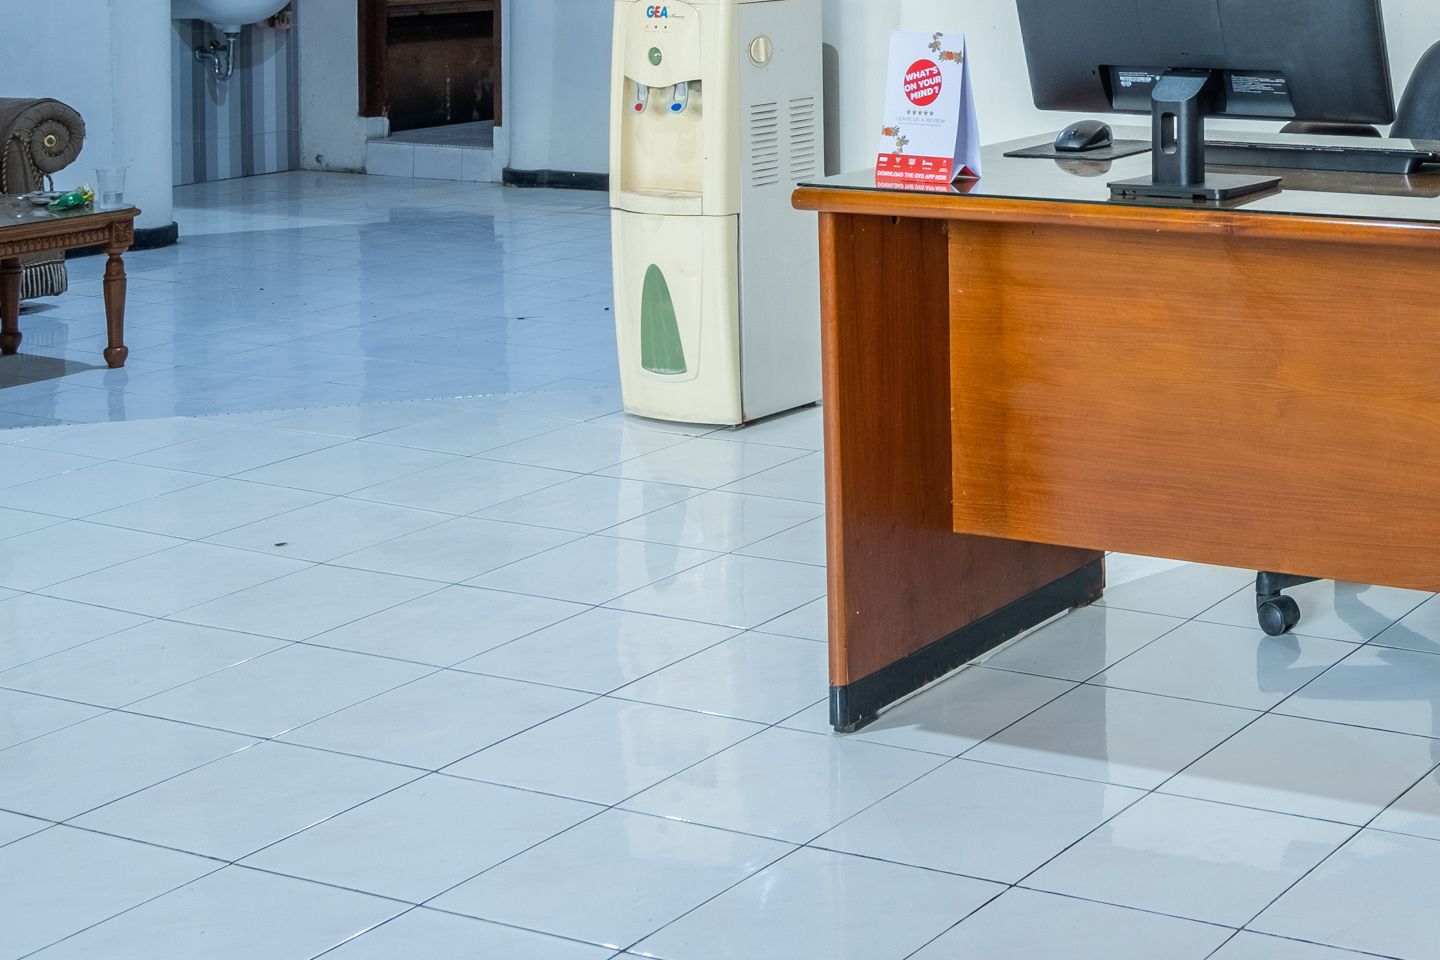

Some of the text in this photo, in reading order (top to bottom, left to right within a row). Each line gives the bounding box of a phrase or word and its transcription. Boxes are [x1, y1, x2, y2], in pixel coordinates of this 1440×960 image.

[646, 5, 669, 19] GEA
[905, 66, 939, 82] WHAT'S
[904, 75, 942, 93] ON YOUR
[876, 170, 904, 178] DOWNLOAD
